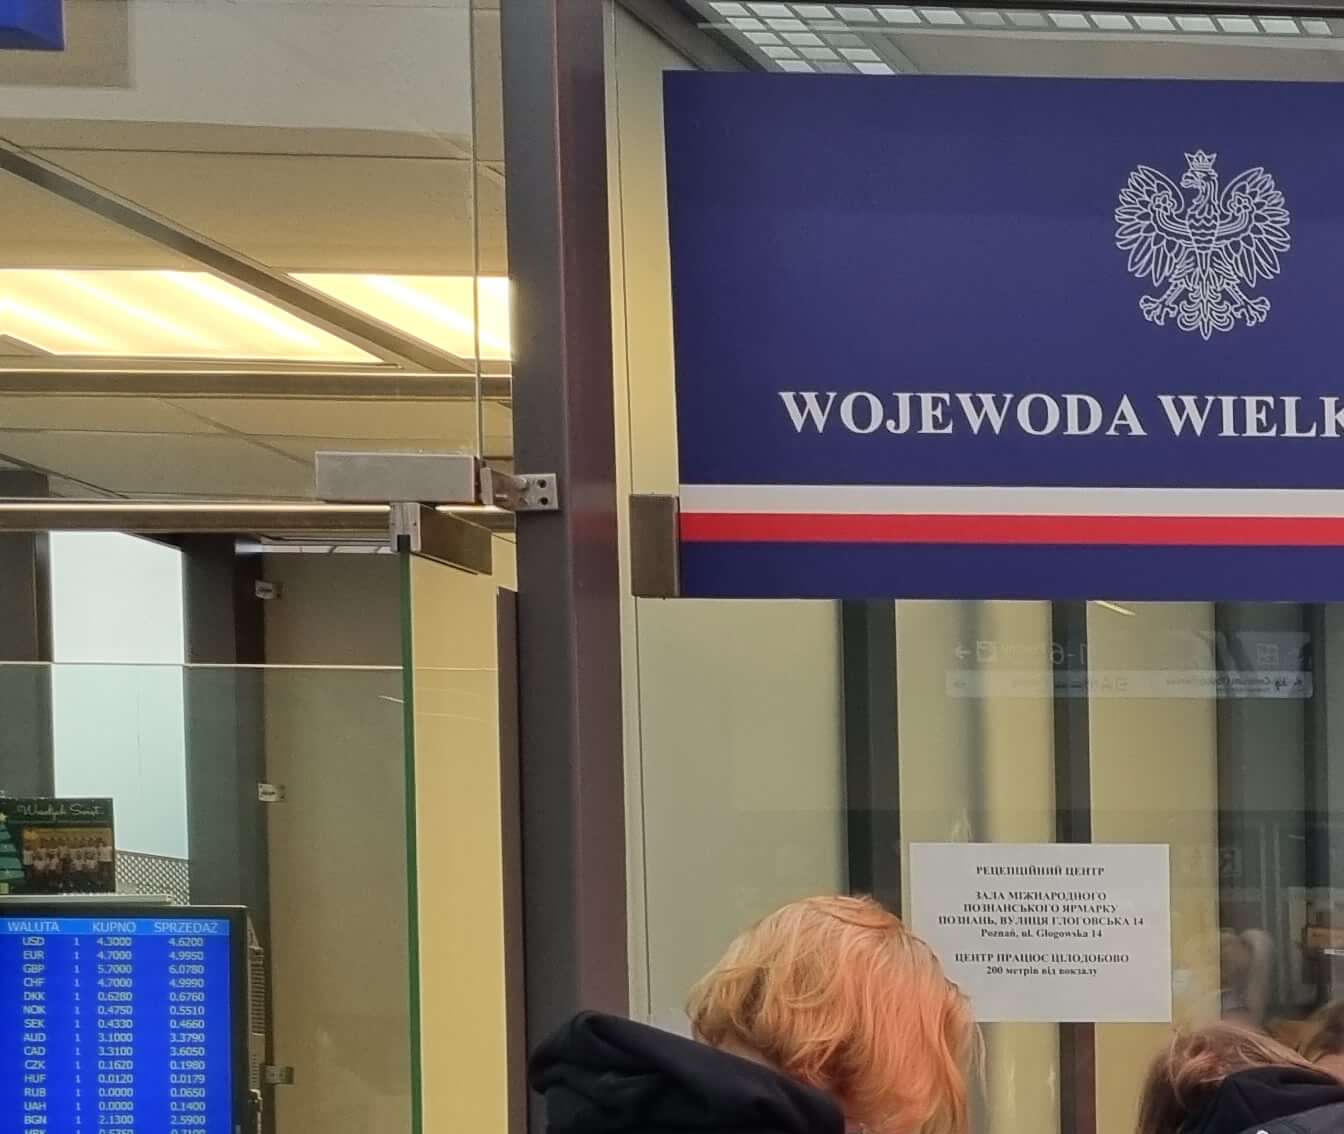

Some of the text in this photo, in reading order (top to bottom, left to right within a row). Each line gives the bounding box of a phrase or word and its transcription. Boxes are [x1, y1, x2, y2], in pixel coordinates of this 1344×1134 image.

[779, 389, 1148, 438] WOJEWODA
[7, 921, 60, 933] WALUTA
[92, 921, 137, 933] KUPNO
[23, 1073, 46, 1084] HUF
